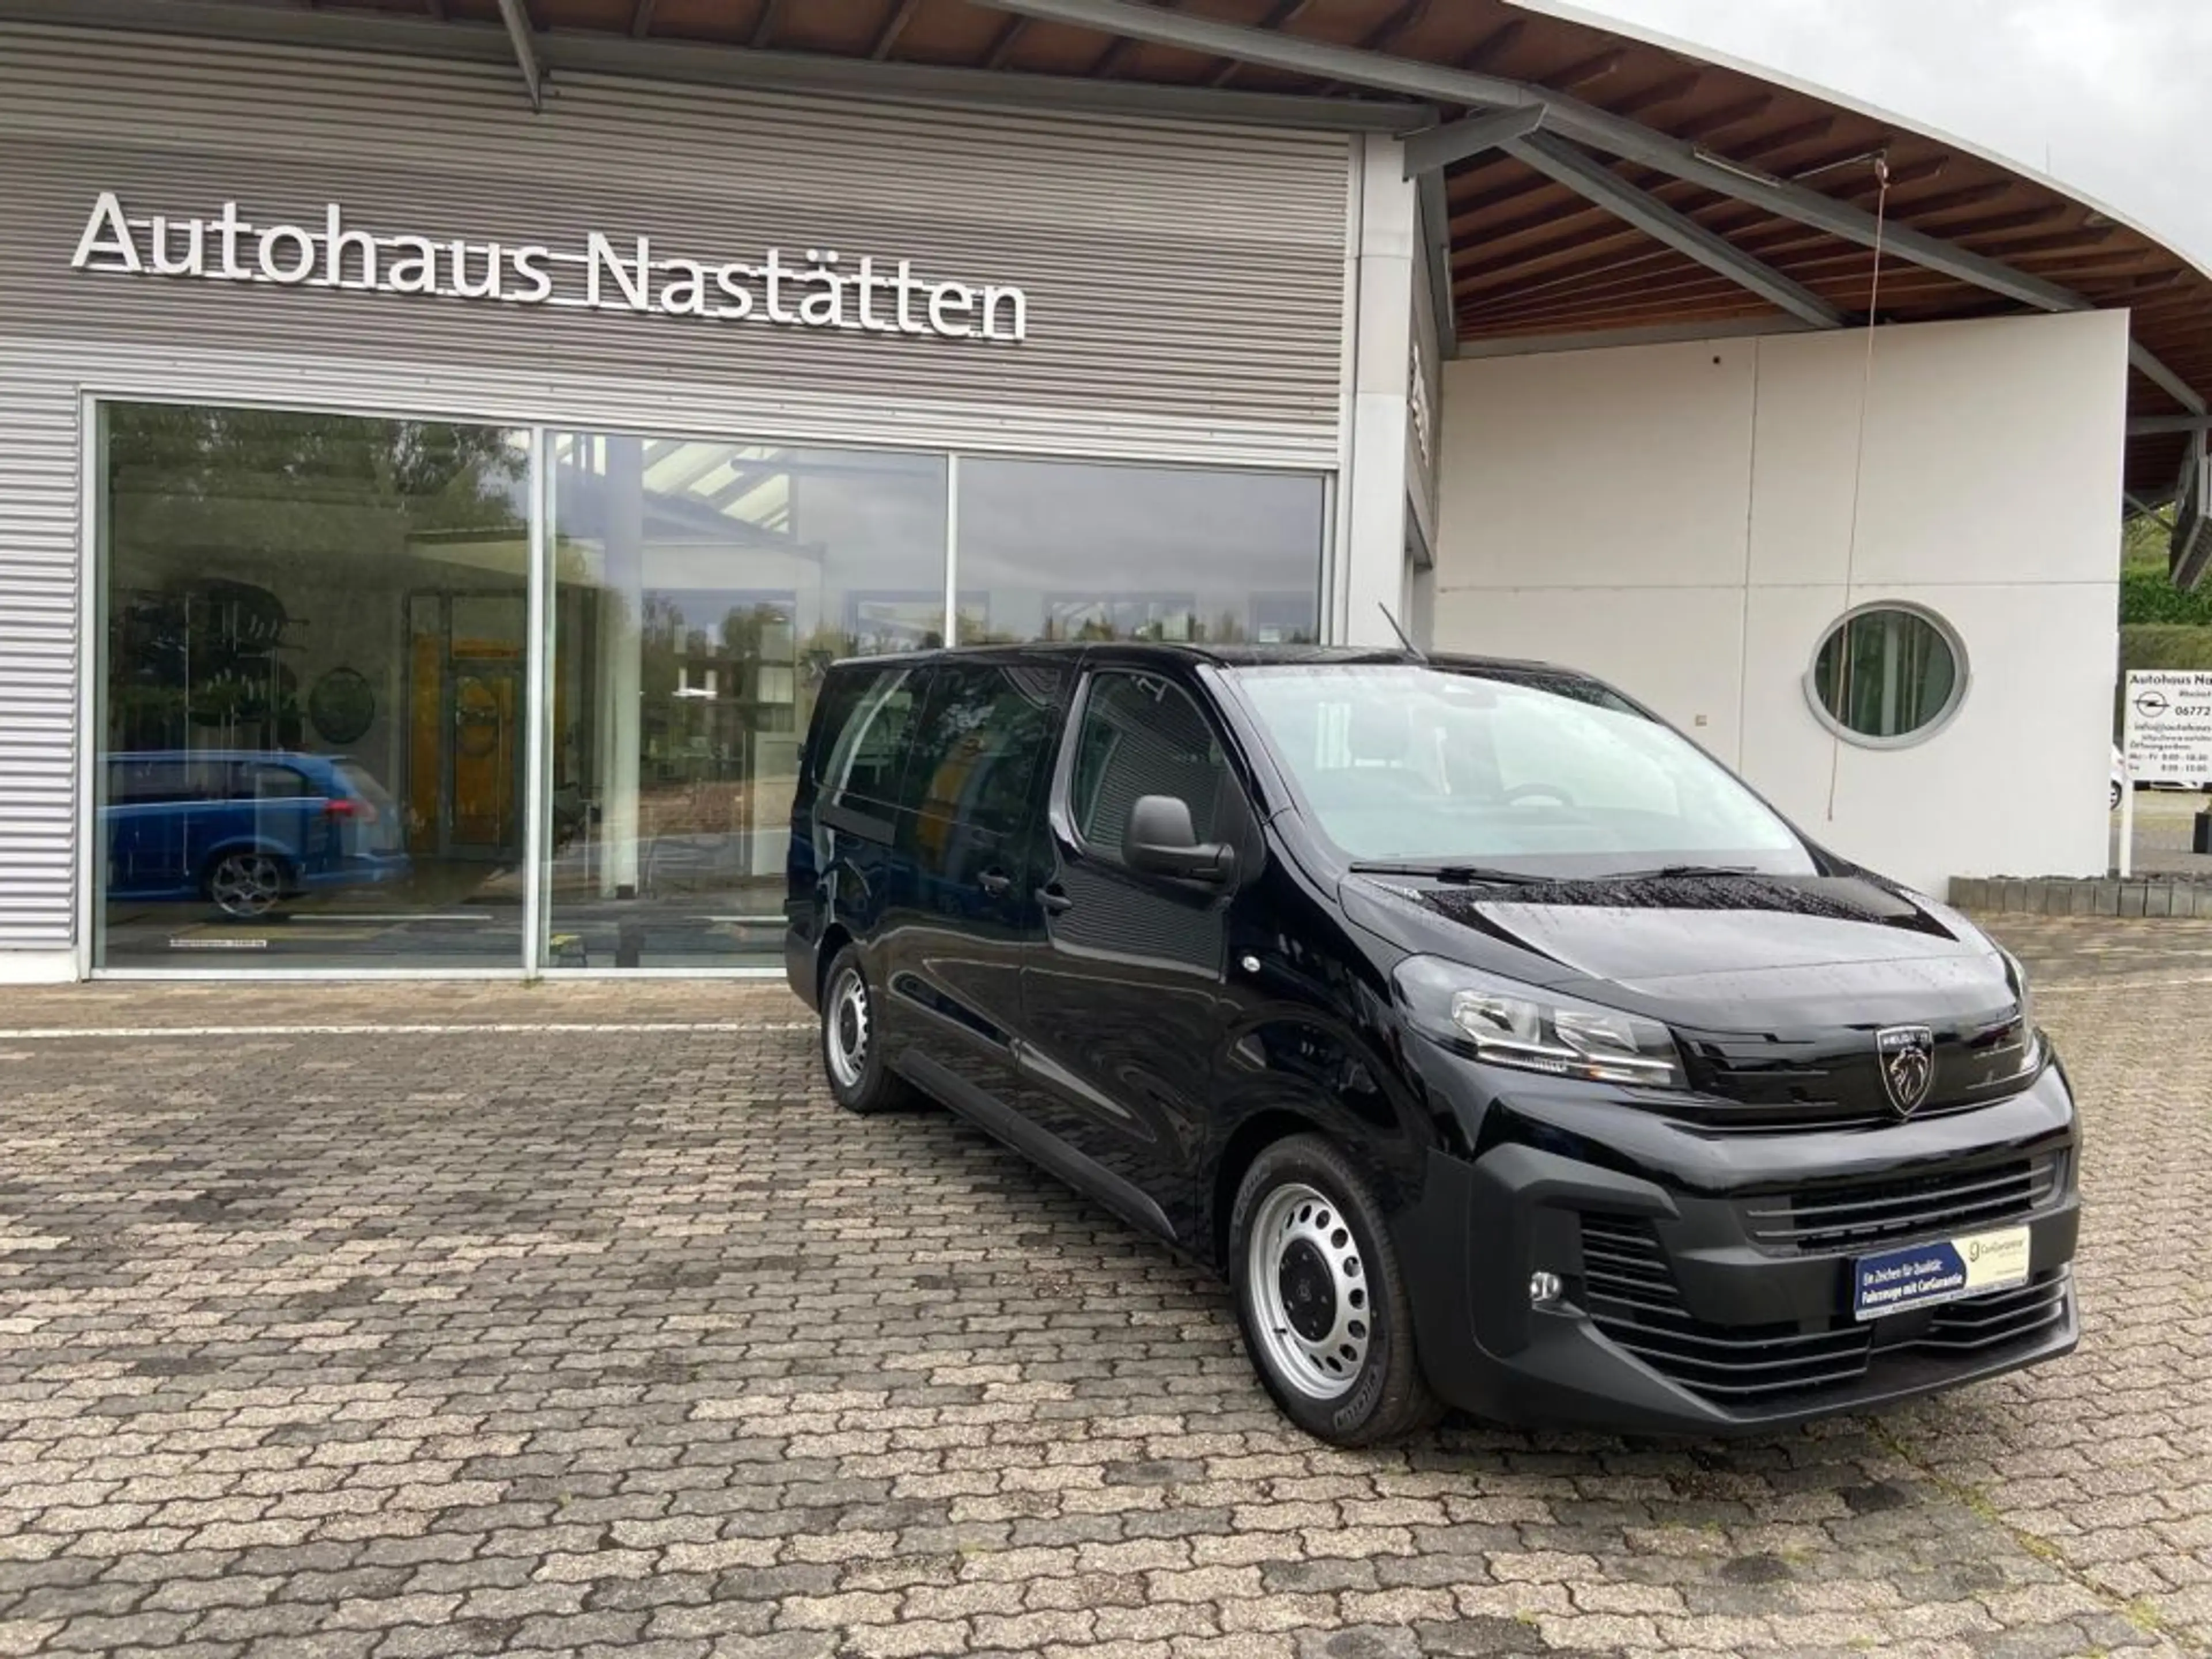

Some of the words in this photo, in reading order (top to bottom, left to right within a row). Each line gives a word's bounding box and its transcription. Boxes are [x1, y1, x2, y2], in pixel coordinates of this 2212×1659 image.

[71, 191, 553, 303] Autohaus
[586, 232, 1027, 343] Nastätten
[2130, 674, 2191, 685] Autohaus
[2175, 706, 2211, 717] 06772
[1874, 1267, 1901, 1284] Zeichen
[1862, 1287, 1902, 1306] Fahrzeuge
[1903, 1281, 1918, 1296] mit
[1918, 1272, 1963, 1293] CarGarantie
